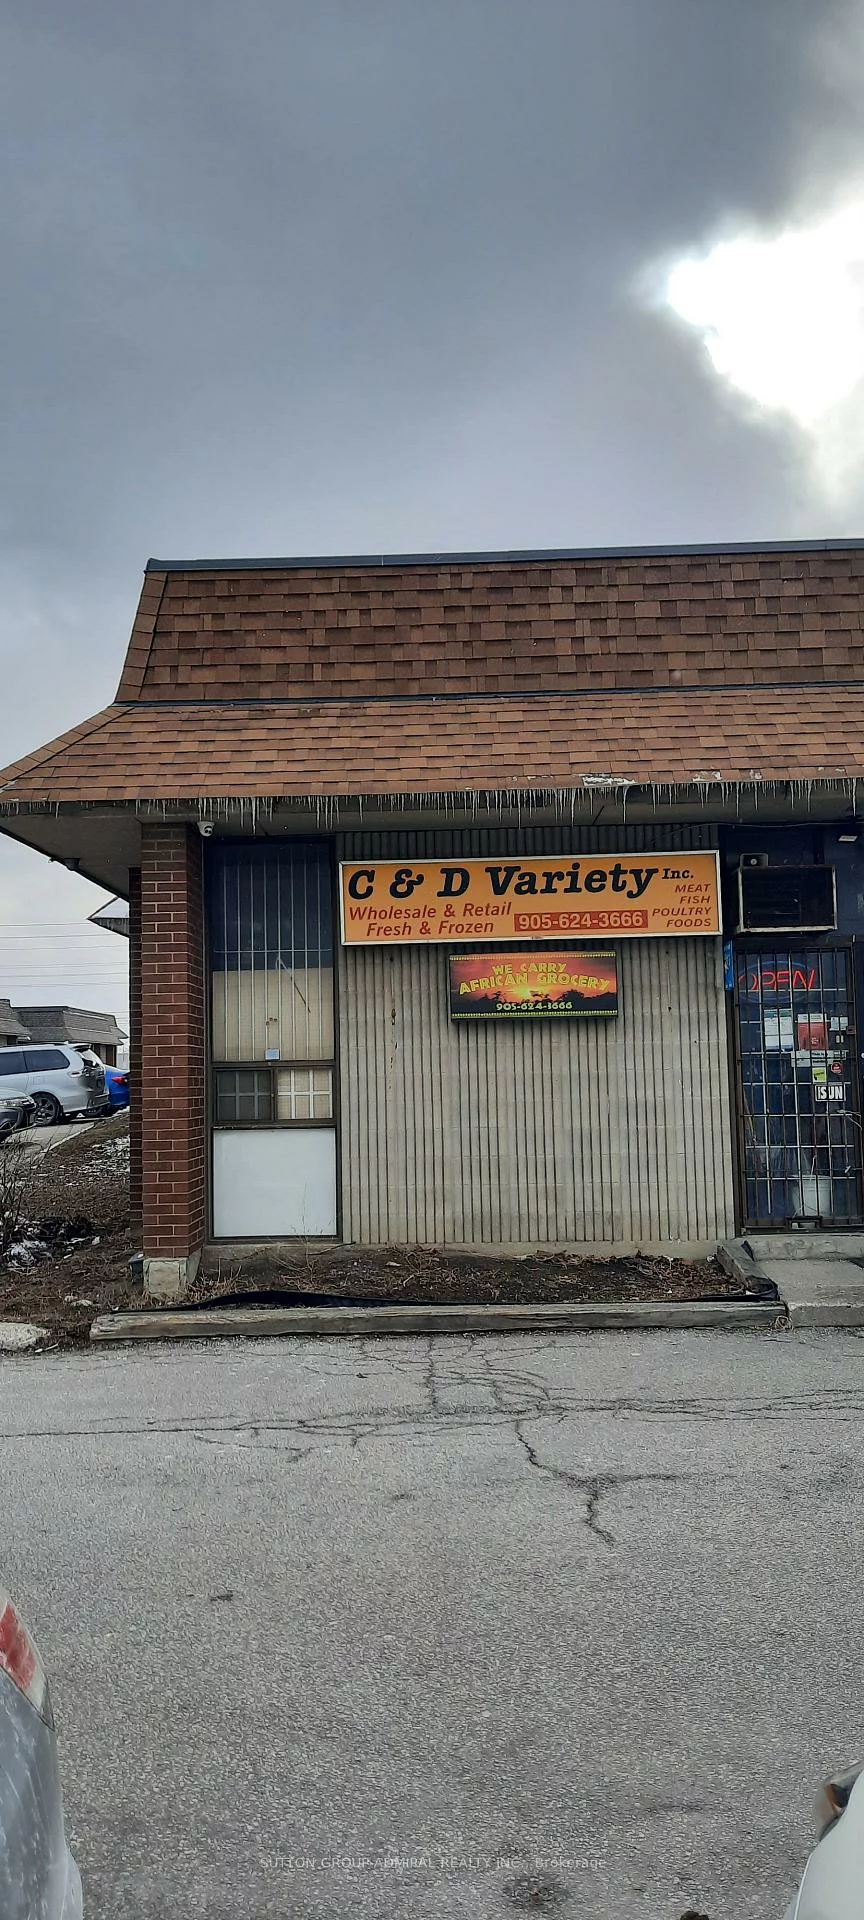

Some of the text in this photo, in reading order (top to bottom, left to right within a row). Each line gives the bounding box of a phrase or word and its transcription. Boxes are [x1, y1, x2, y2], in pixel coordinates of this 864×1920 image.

[348, 862, 694, 900] C & D Variety Inc.
[674, 883, 711, 893] MEAT
[679, 895, 711, 904] FISH
[349, 901, 512, 921] Wholesale & Retail
[652, 906, 711, 917] POULTRY
[366, 919, 494, 937] Fresh & Frozen
[518, 911, 643, 930] 905-624-3666
[666, 918, 711, 928] FOODS
[491, 963, 567, 975] WE CARRY
[459, 972, 610, 995] AFRICAN GROCERY
